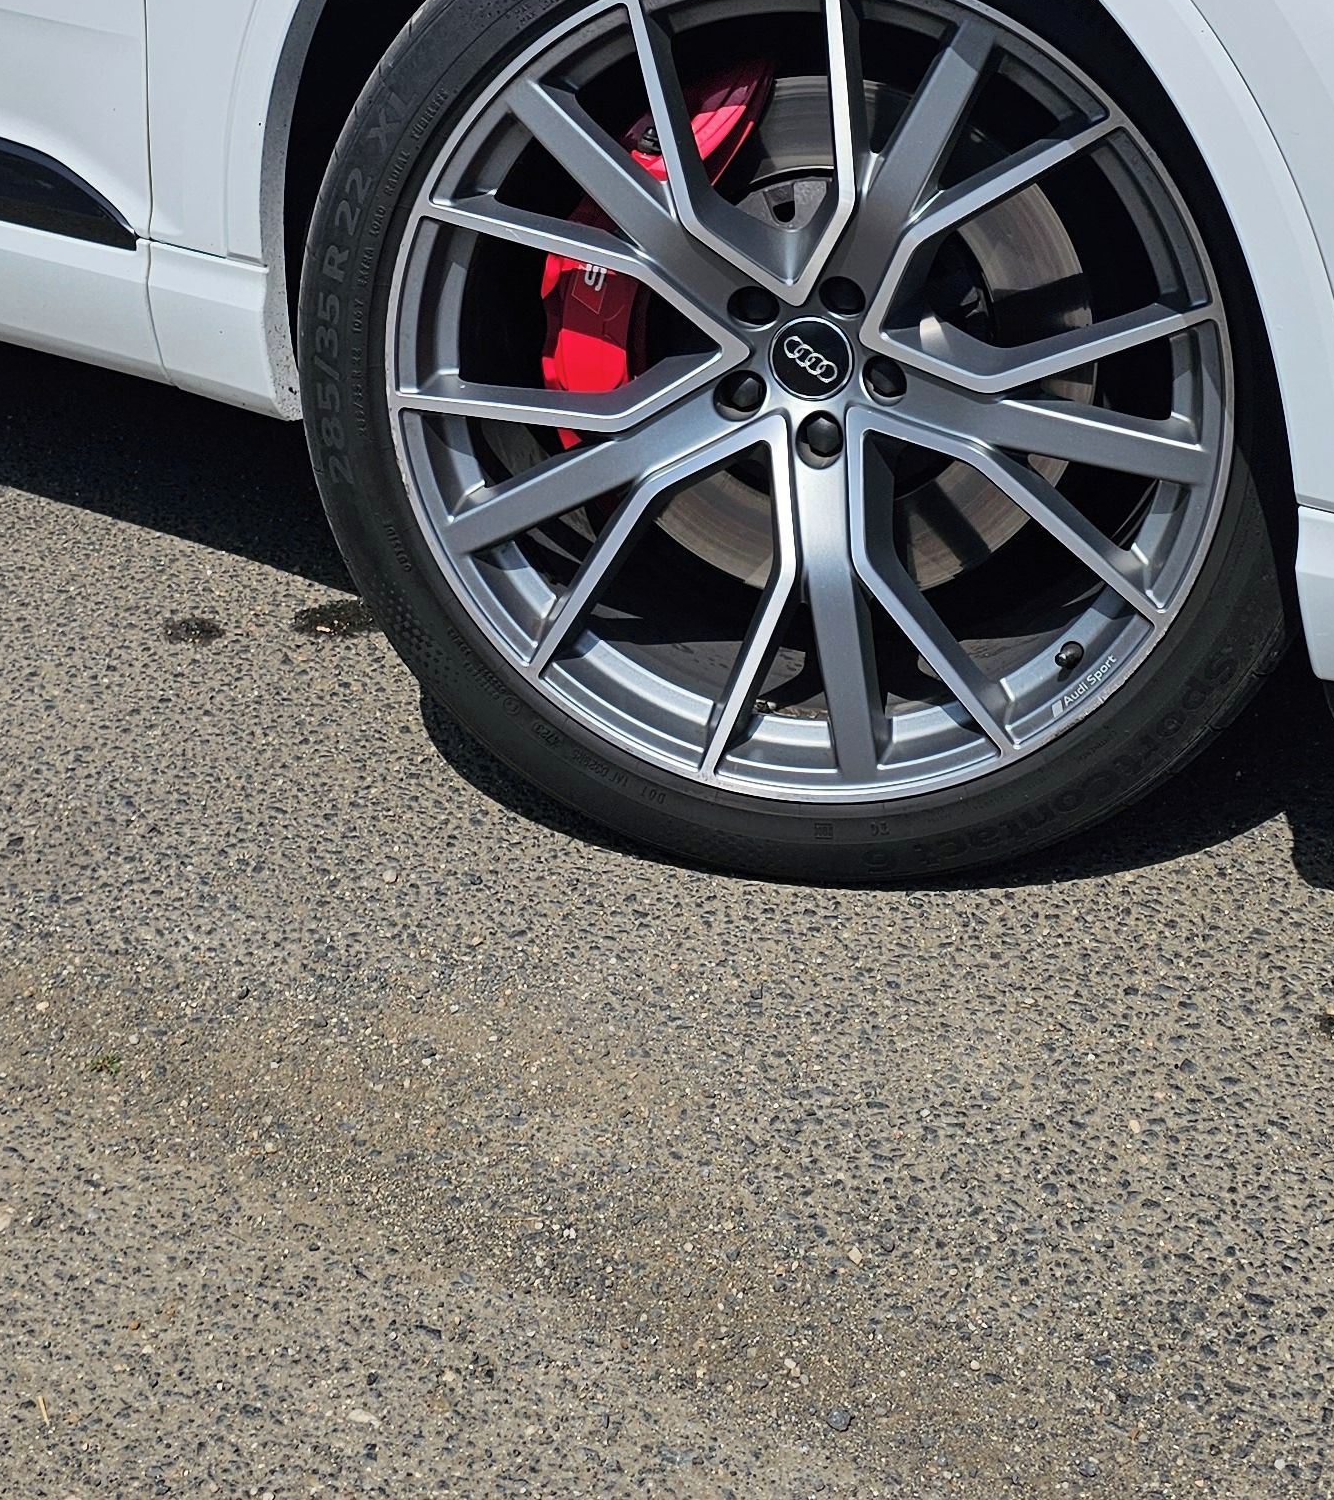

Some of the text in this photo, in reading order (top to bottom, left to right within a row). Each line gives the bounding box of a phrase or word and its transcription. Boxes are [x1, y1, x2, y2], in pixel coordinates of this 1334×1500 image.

[314, 92, 417, 485] 285/35 R 22 XL
[1063, 654, 1116, 706] Audi Sport
